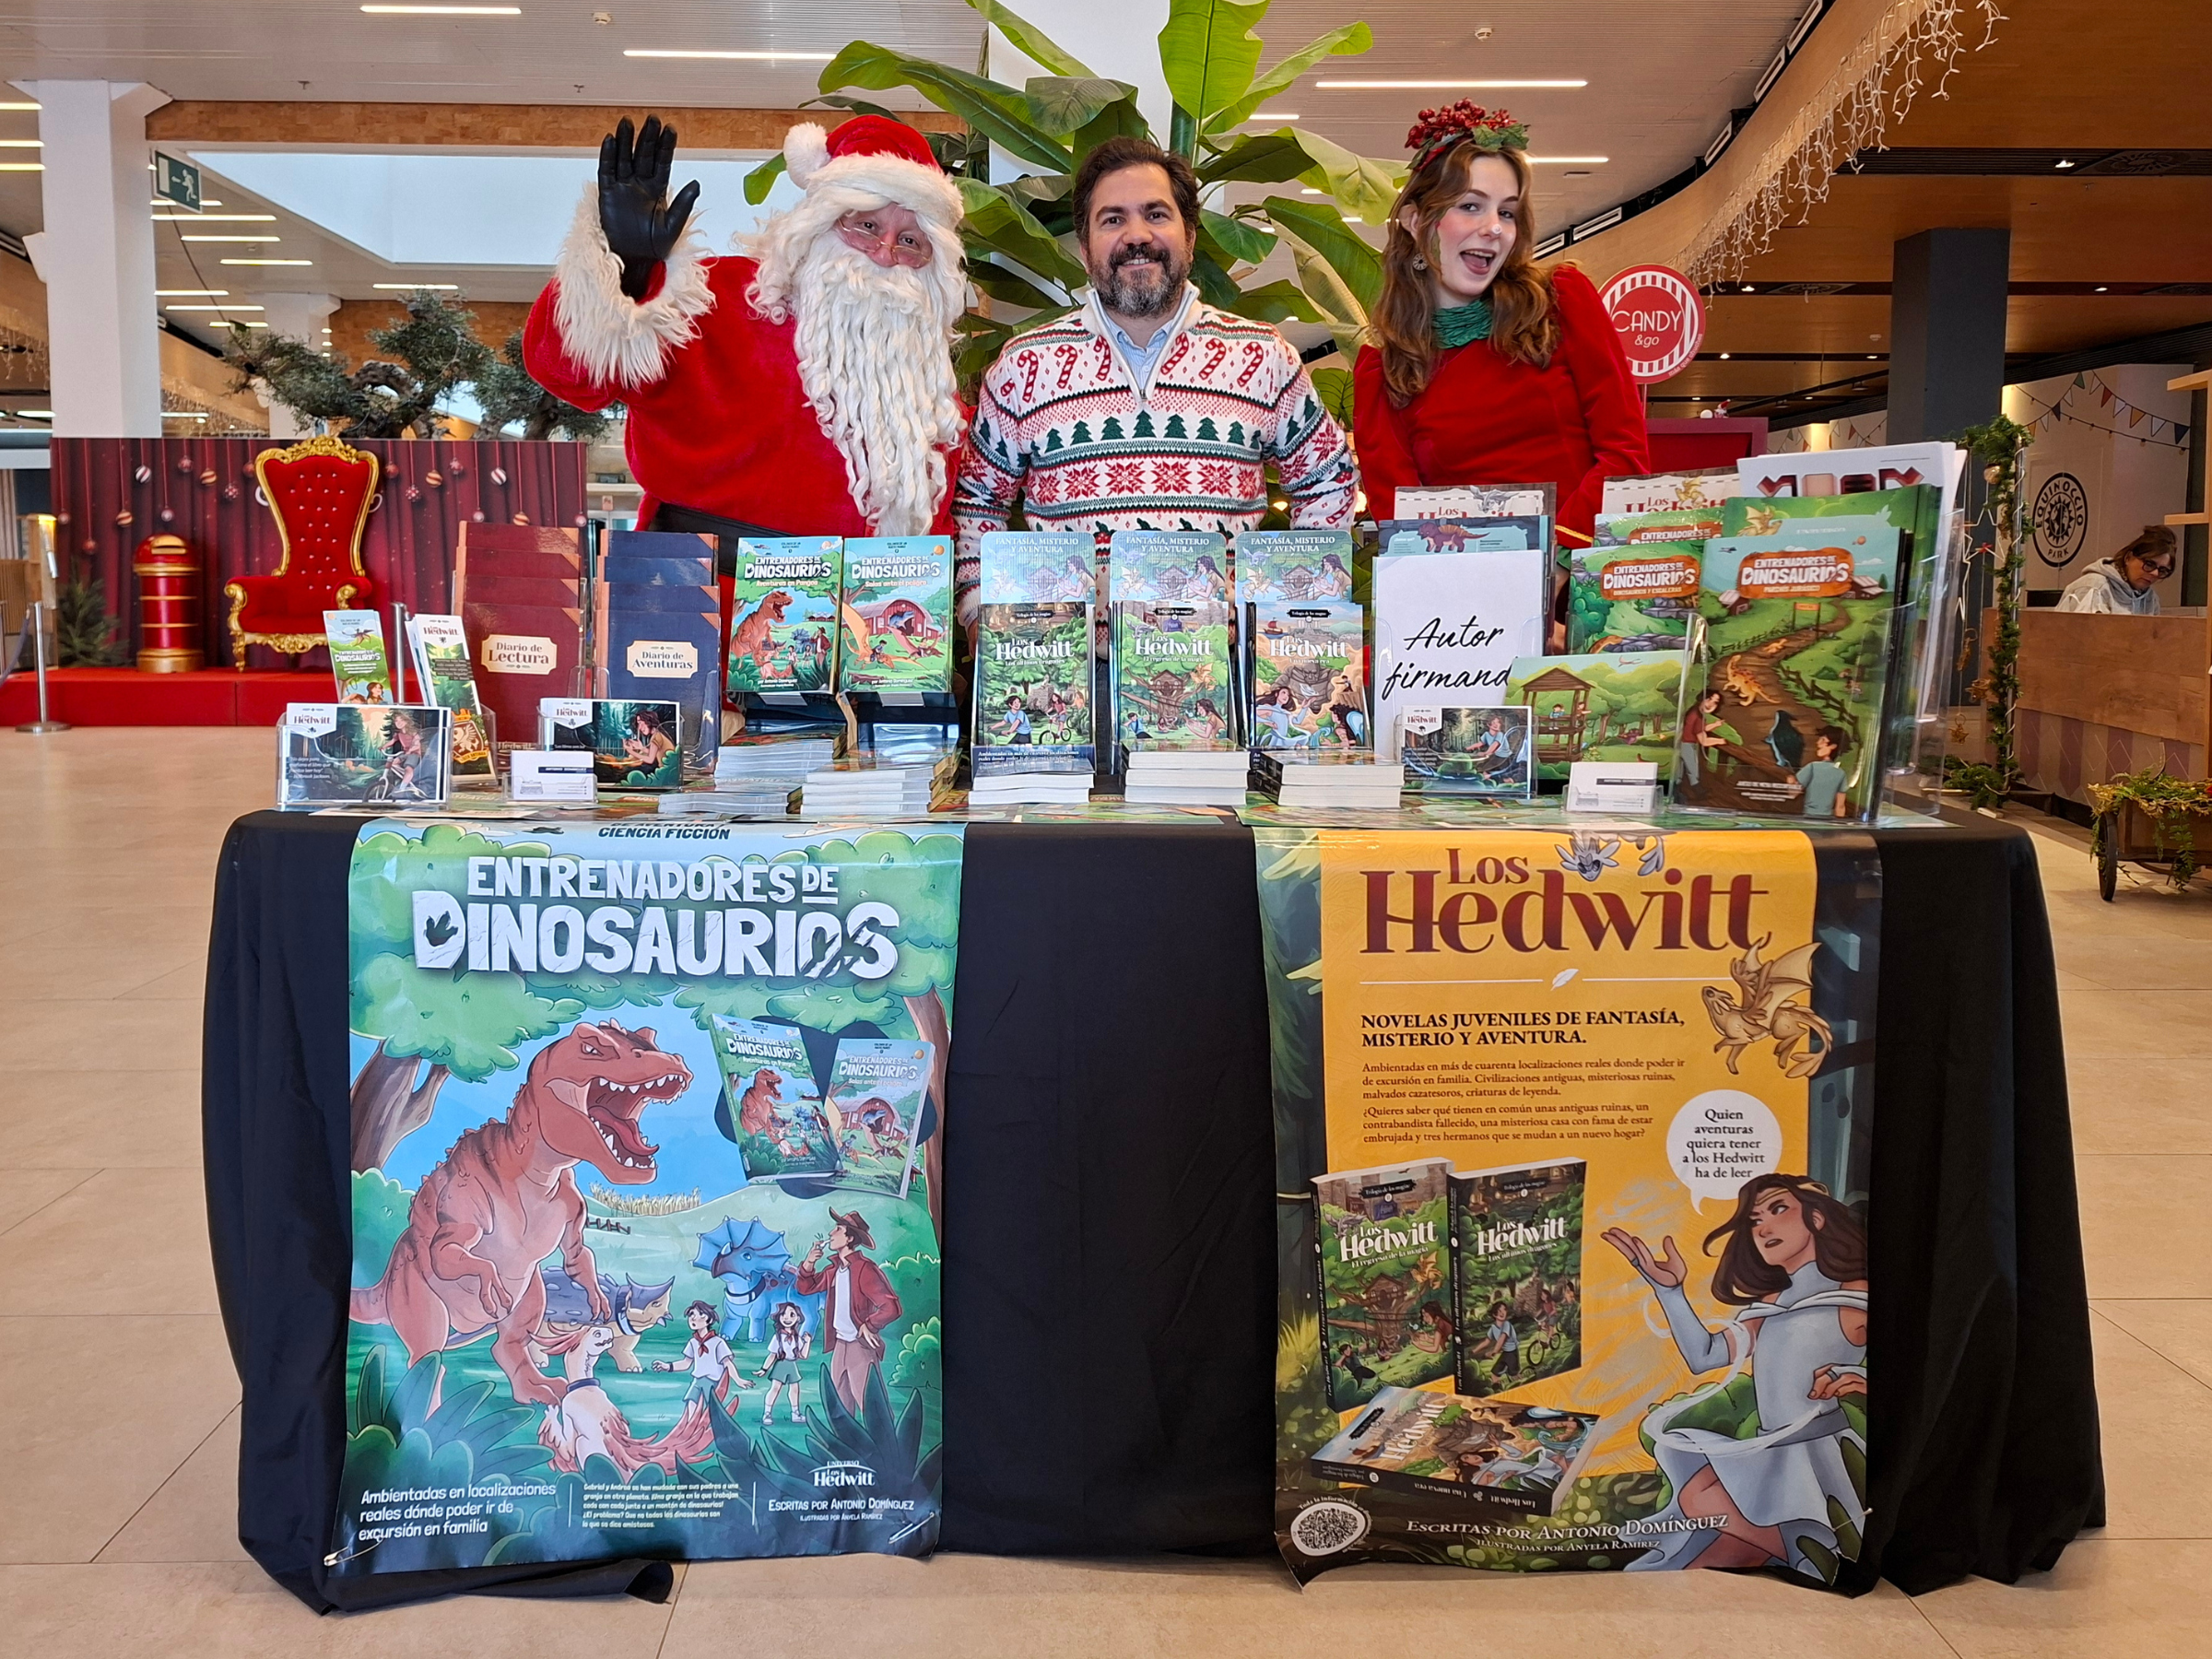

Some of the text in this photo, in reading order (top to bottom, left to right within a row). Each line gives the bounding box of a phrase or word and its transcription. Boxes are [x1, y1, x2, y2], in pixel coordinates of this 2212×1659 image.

[1613, 311, 1682, 332] CANDY
[1634, 334, 1659, 348] &go
[1648, 497, 1669, 506] Los
[2036, 479, 2084, 529] EQUINOCCIO
[1439, 507, 1458, 515] Los
[995, 537, 1037, 546] FANTASÍA,
[1126, 536, 1168, 545] FANTASÍA,
[1251, 536, 1293, 545] FANTASÍA,
[1641, 529, 1703, 540] ENTRENADORES
[755, 556, 813, 565] ENTRENADORES
[862, 556, 922, 565] ENTRENADORES
[2047, 547, 2069, 559] PARK
[1614, 563, 1676, 574] ENTRENADORES
[1754, 556, 1827, 569] ENTRENADORES
[745, 562, 832, 579] DINOSAURIOS
[852, 562, 940, 579] DINOSAURIOS
[1741, 562, 1850, 585] DINOSAURIOS
[1603, 568, 1696, 589] DINOSAURIOS
[1404, 615, 1504, 651] Autor
[496, 642, 543, 653] Diario de
[995, 641, 1075, 660] Hedwitt
[1135, 638, 1214, 655] Hedwitt
[1269, 639, 1349, 657] Hedwitt
[488, 649, 549, 665] Lectura
[641, 651, 684, 660] Diario de
[632, 659, 693, 669] Aventuras
[1382, 656, 1518, 700] firmand
[294, 716, 331, 724] Hedwitt
[556, 708, 588, 717] Hedwitt
[598, 827, 730, 840] CIENCIA FICCIÓN
[1447, 848, 1530, 885] Los
[467, 855, 839, 903] ENTRENADORES DE
[1359, 867, 1771, 953] Hedwitt
[412, 890, 900, 980] DINOSAURIOS
[1360, 1008, 1684, 1029] NOVELAS JUVENILES DE FANTASÍA,
[1362, 1030, 1585, 1046] MISTERIO Y AVENTURA.
[726, 1038, 803, 1060] DINOSAURIOS
[839, 1062, 918, 1079] DINOSAURIOS
[1362, 1062, 1424, 1072] Ambientadas
[1441, 1061, 1459, 1070] más
[1462, 1061, 1473, 1069] de
[1518, 1059, 1583, 1068] localizaciones
[1585, 1059, 1611, 1067] reales
[1613, 1058, 1643, 1066] donde
[1646, 1058, 1674, 1069] poder
[1677, 1058, 1684, 1066] ir
[1362, 1076, 1373, 1085] de
[1375, 1076, 1420, 1085] excursión
[1437, 1074, 1472, 1083] familia.
[1475, 1074, 1540, 1083] Civilizaciones
[1543, 1073, 1584, 1084] antiguas,
[1588, 1072, 1640, 1080] misteriosas
[1642, 1072, 1675, 1080] ruinas,
[1363, 1088, 1406, 1099] malvados
[1465, 1088, 1506, 1096] criaturas
[1509, 1087, 1520, 1095] de
[1523, 1087, 1560, 1098] leyenda.
[1363, 1106, 1404, 1117] ¿Quieres
[1406, 1106, 1430, 1114] saber
[1432, 1105, 1451, 1116] qué
[1453, 1105, 1482, 1113] tienen
[1499, 1104, 1532, 1112] común
[1559, 1103, 1598, 1114] antiguas
[1601, 1102, 1633, 1112] ruinas,
[1705, 1109, 1744, 1123] Quien
[1694, 1125, 1754, 1134] aventuras
[1687, 1138, 1761, 1152] quiera tener
[1693, 1152, 1709, 1163] los
[1712, 1152, 1765, 1163] Hedwitt
[1695, 1167, 1753, 1178] ha de leer
[1360, 1226, 1382, 1237] Los
[1477, 1217, 1569, 1255] Hedwitt
[1340, 1220, 1439, 1262] Hedwitt
[814, 1470, 876, 1487] Hedwitt
[361, 1483, 555, 1504] Ambientadas en localizaciones
[359, 1500, 512, 1522] reales dónde poder ir de
[769, 1498, 913, 1511] ESCRITAS POR ANTONIO DOMÍNGUEZ
[359, 1519, 488, 1541] excursión en familia
[1406, 1514, 1729, 1541] ESCRITAS POR ANTONIO DOMÍNGUEZ
[1477, 1538, 1661, 1553] ILUSTRADAS POR ANYELA RAMÍREZ
